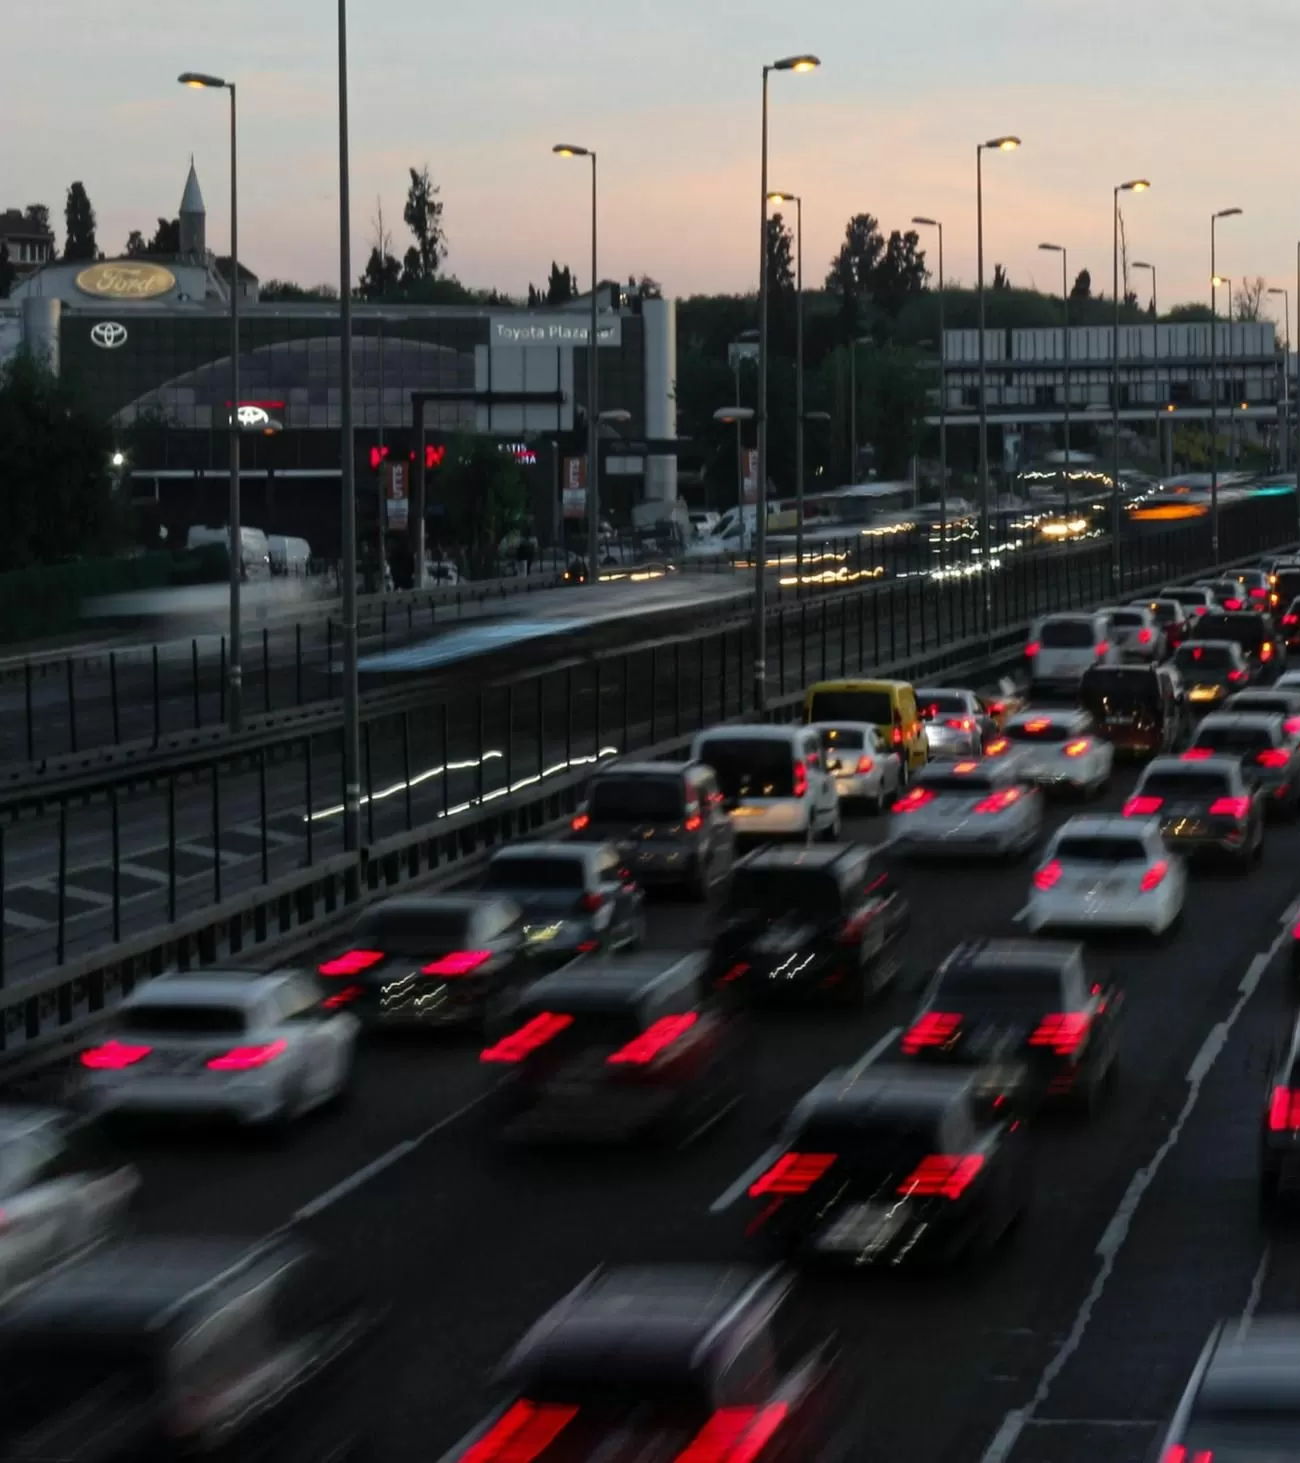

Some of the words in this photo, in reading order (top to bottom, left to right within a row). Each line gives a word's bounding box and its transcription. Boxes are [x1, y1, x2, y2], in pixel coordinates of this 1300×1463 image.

[96, 267, 154, 292] Ford
[496, 324, 545, 341] Toyota
[549, 324, 588, 339] Plaza
